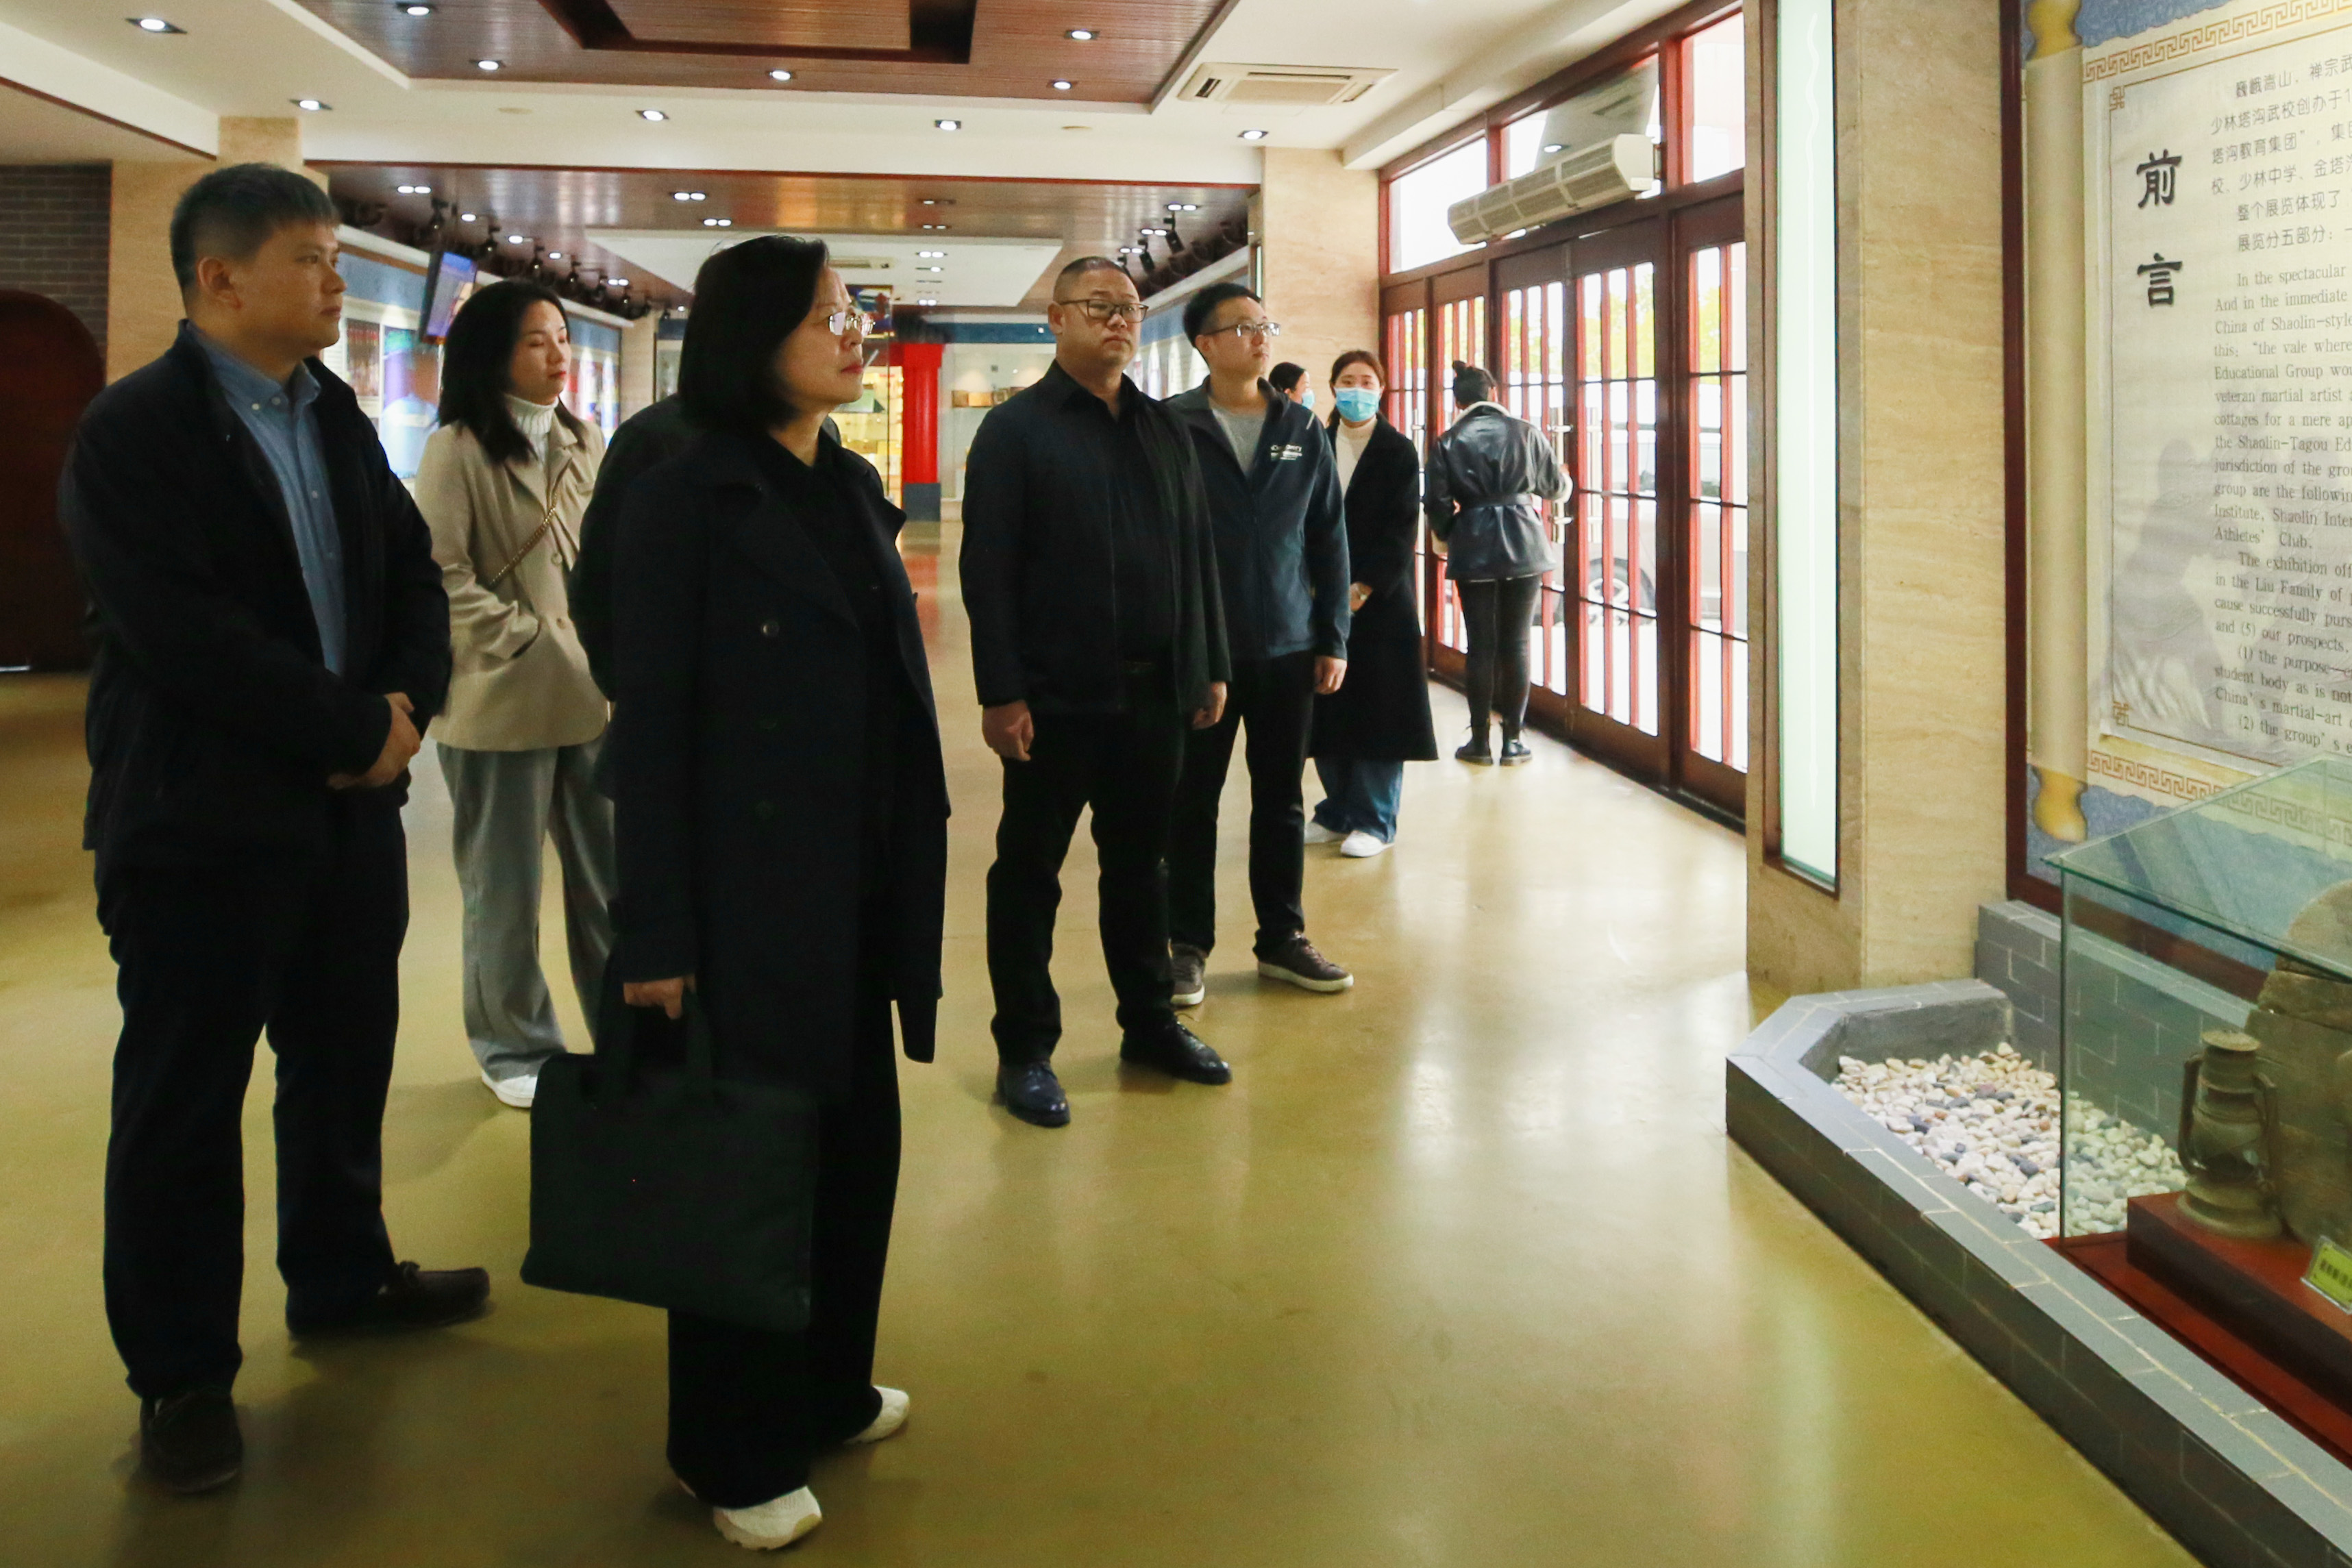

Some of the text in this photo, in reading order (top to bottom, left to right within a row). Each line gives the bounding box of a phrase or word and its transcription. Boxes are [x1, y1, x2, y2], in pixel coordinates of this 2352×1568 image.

[2136, 149, 2183, 308] 前言
[2237, 264, 2346, 286] In the spectacular
[2215, 289, 2347, 311] And in the immediate
[2215, 320, 2247, 334] China
[2254, 318, 2265, 332] of
[2283, 340, 2307, 353] vale
[2314, 339, 2352, 353] where
[2214, 365, 2279, 379] Educational
[2286, 364, 2323, 379] Group
[2214, 390, 2255, 402] veteran
[2262, 388, 2303, 402] martial
[2310, 388, 2342, 402] artist
[2214, 413, 2259, 427] cottages
[2265, 412, 2281, 425] for
[2289, 416, 2294, 425] a
[2303, 416, 2331, 426] mere
[2215, 436, 2232, 448] the
[2214, 459, 2277, 473] jurisdiction
[2283, 460, 2295, 474] of
[2303, 462, 2321, 475] the
[2214, 484, 2246, 497] group
[2253, 487, 2270, 497] are
[2277, 485, 2295, 499] the
[2273, 508, 2317, 526] Shaolin
[2238, 551, 2260, 567] The
[2266, 556, 2327, 575] exhibition
[2216, 573, 2225, 586] in
[2232, 575, 2249, 589] the
[2281, 580, 2323, 599] Family
[2330, 587, 2342, 601] of
[2215, 598, 2243, 611] cause
[2250, 603, 2317, 625] successfully
[2216, 621, 2235, 633] and
[2262, 629, 2281, 641] our
[2260, 649, 2277, 664] the
[2215, 666, 2253, 684] student
[2261, 673, 2289, 693] body
[2297, 683, 2309, 695] as
[2316, 683, 2326, 697] is
[2260, 720, 2278, 736] the
